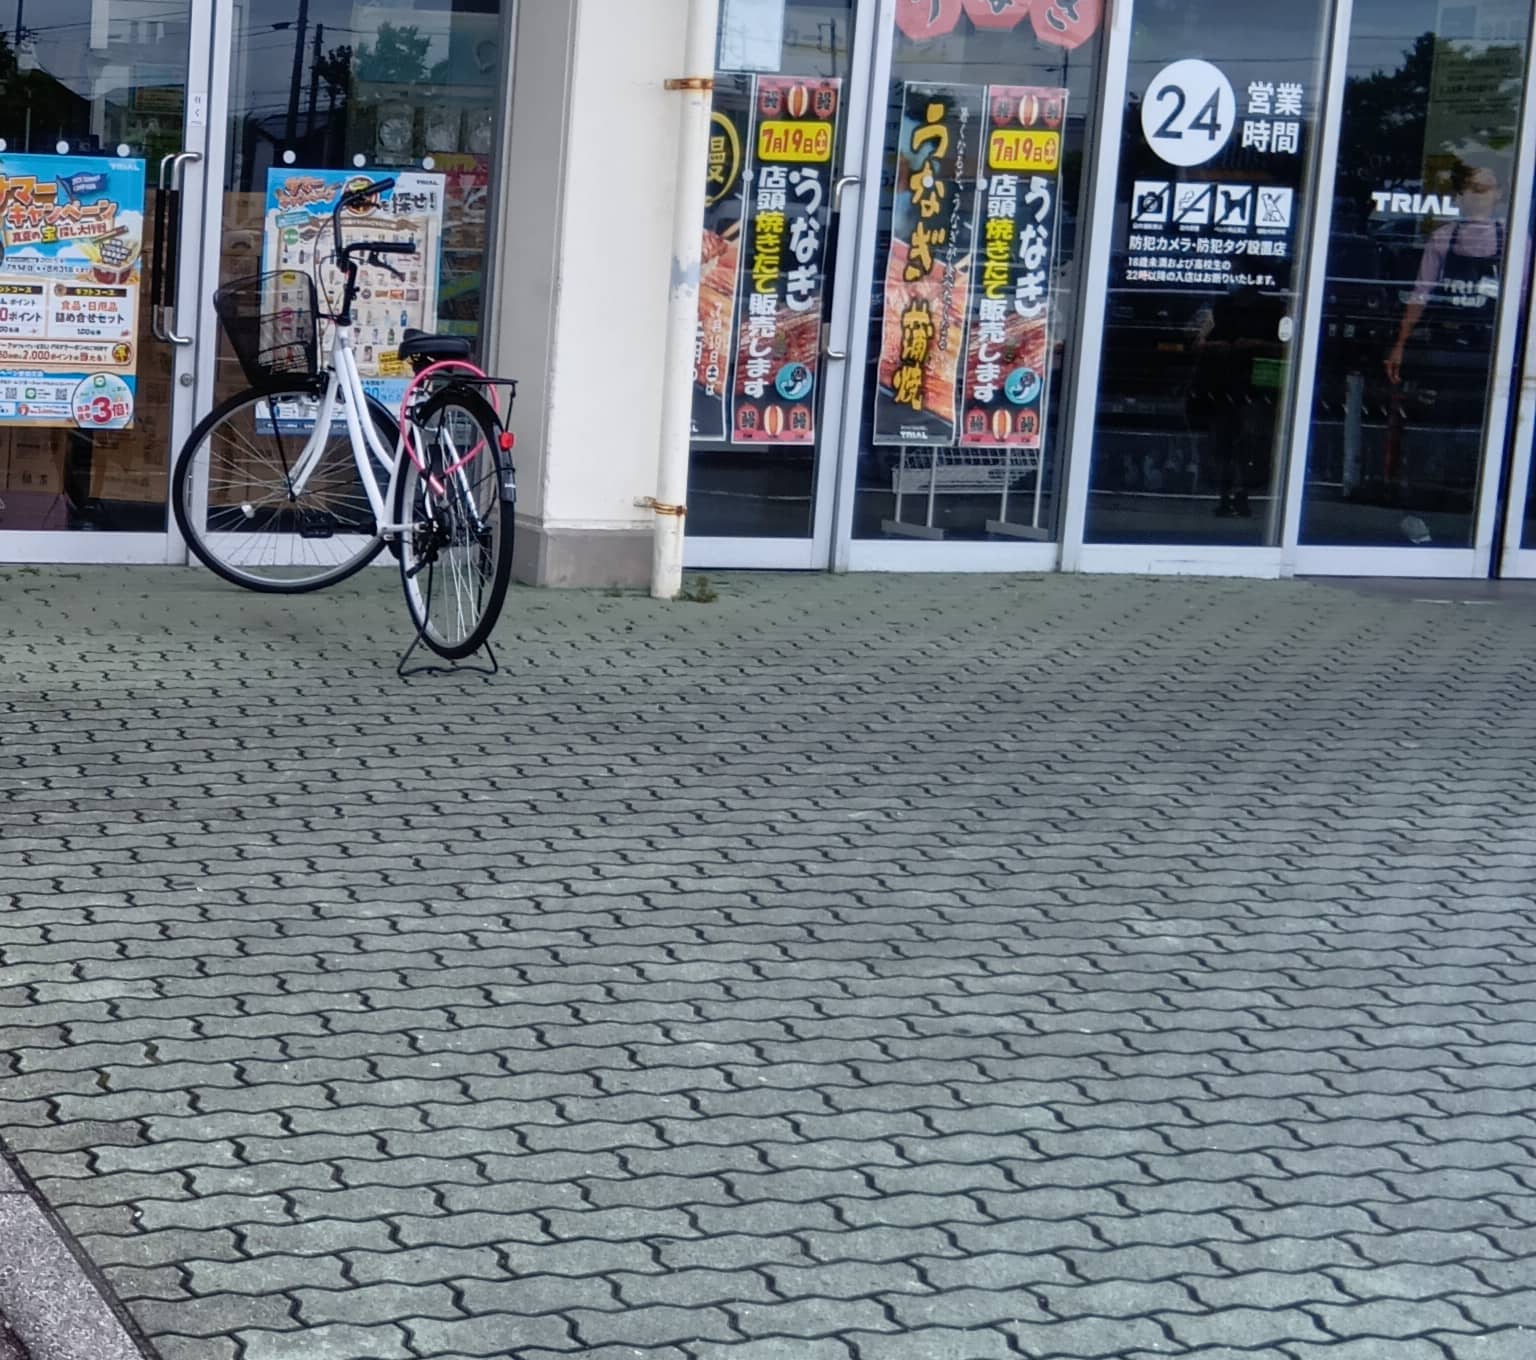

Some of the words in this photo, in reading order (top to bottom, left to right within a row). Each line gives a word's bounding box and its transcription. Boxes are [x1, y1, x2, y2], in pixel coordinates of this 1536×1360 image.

[1152, 85, 1221, 140] 24
[1248, 81, 1304, 116] 営業
[1241, 120, 1300, 153] 時間
[8, 199, 117, 226] キャンペーン
[1371, 191, 1460, 216] TRIAL
[744, 166, 788, 398] 店頭焼きたて販売します
[973, 175, 1017, 402] 店頭焼きたて販売します
